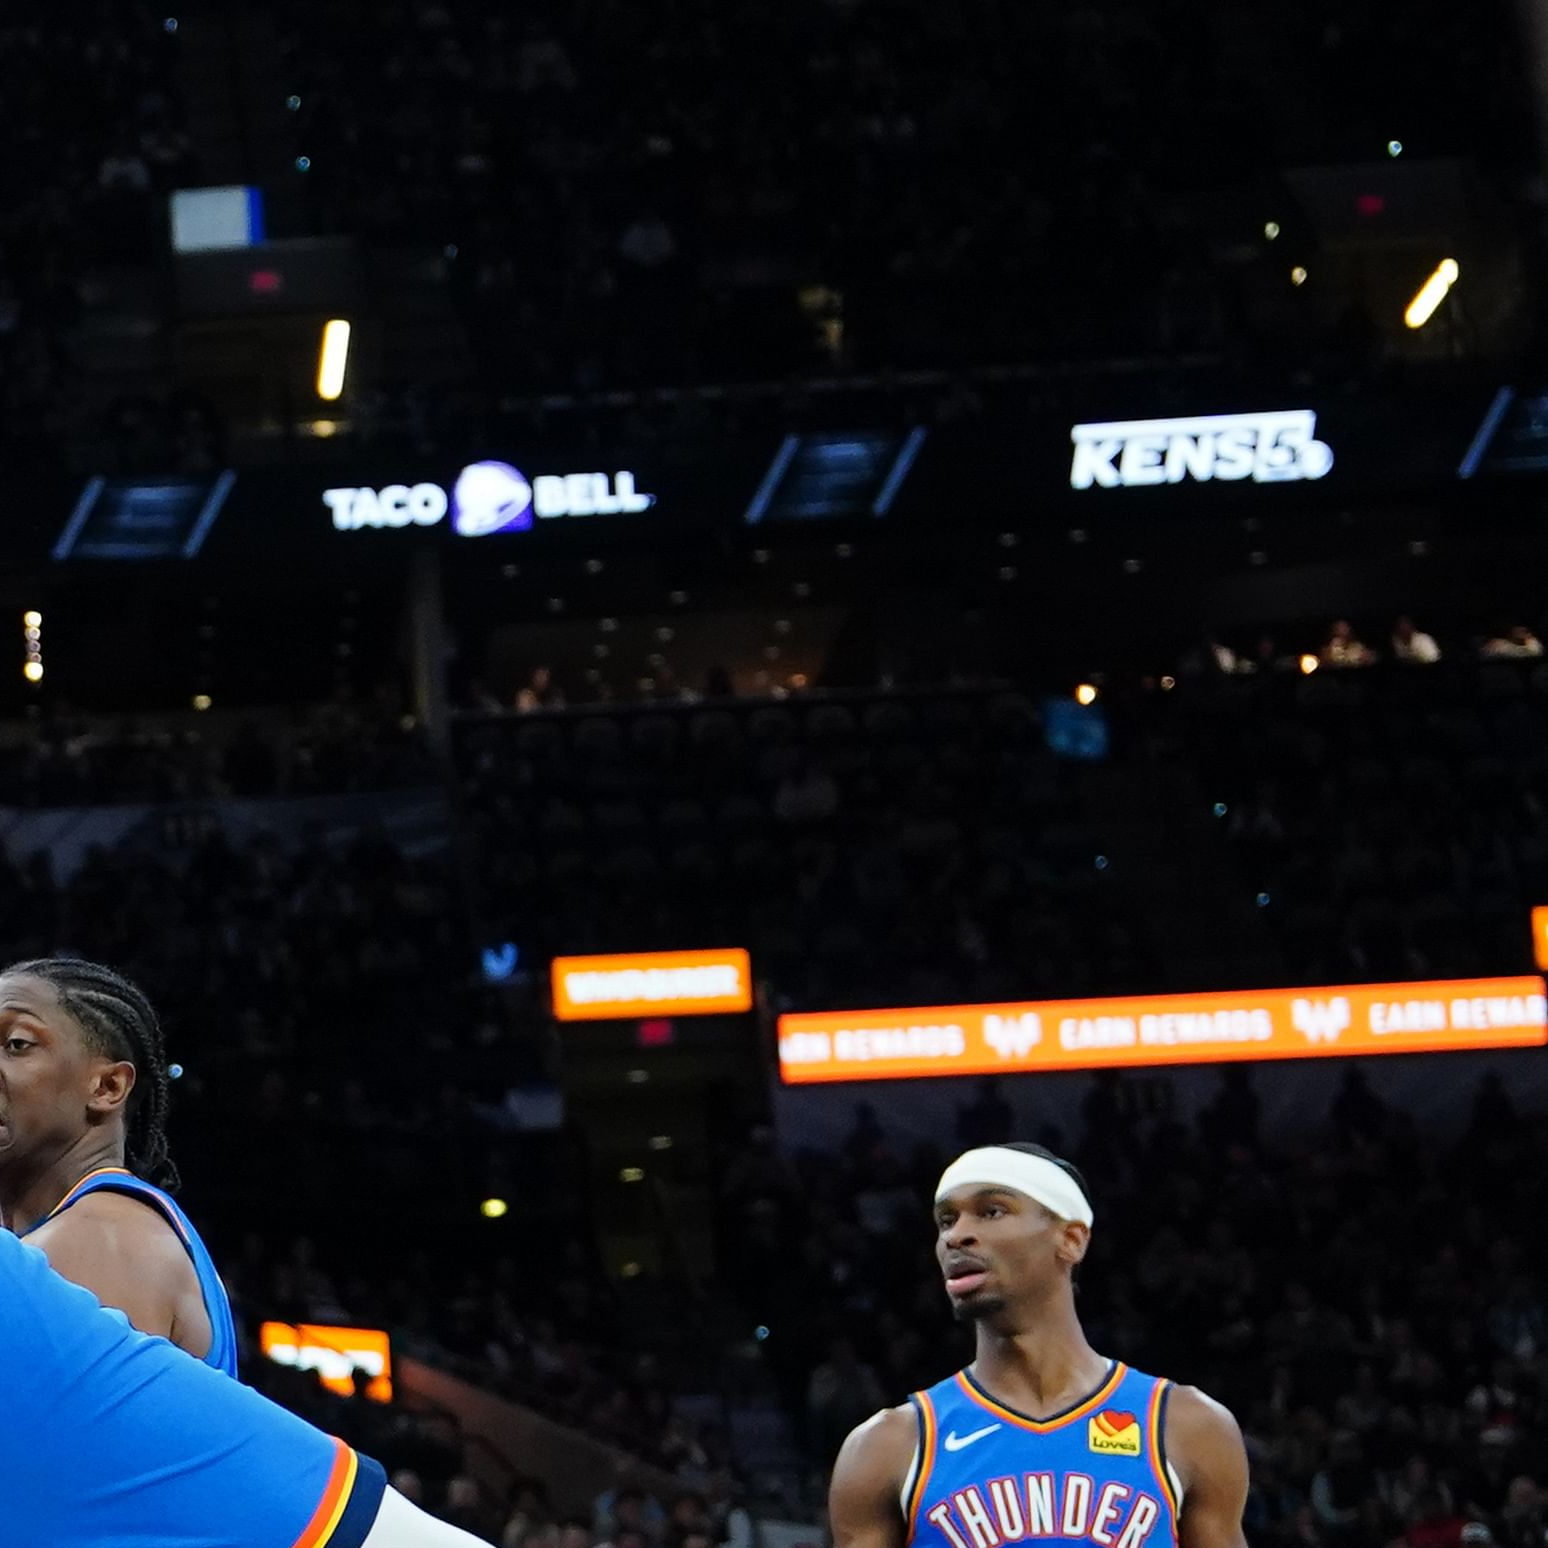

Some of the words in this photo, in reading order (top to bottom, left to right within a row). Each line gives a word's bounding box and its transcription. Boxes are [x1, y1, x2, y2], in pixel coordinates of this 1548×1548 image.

[324, 484, 447, 533] TACO
[535, 470, 651, 518] BELL
[1059, 1015, 1136, 1050] EARN
[1369, 1001, 1445, 1034] EARN
